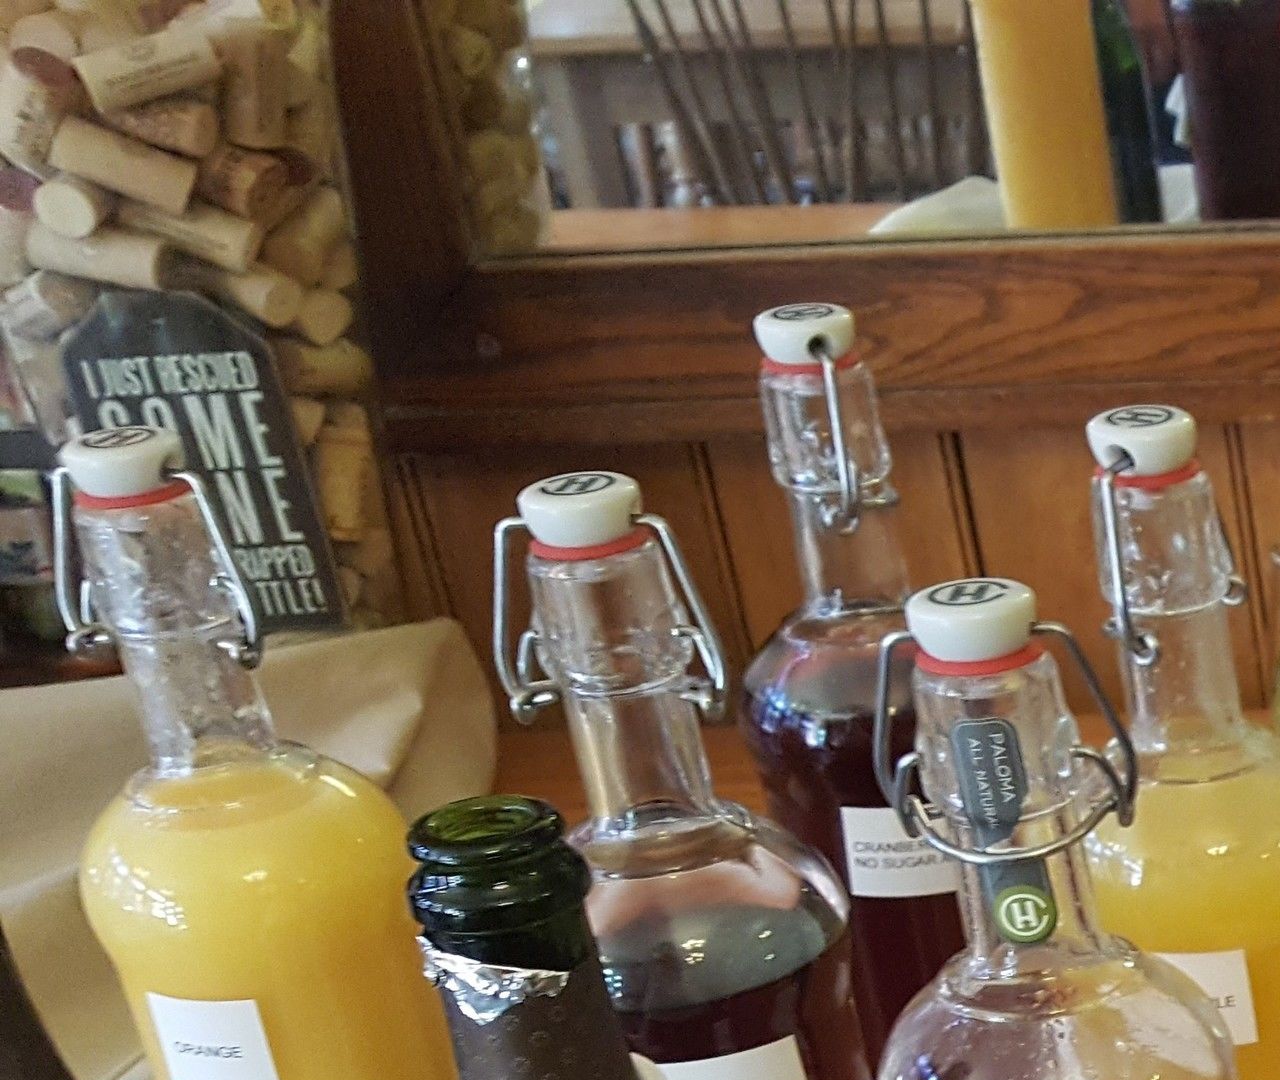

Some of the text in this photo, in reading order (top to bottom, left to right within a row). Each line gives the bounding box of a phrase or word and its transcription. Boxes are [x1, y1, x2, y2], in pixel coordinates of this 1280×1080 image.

[80, 351, 259, 399] I JUST RESCUED
[213, 467, 304, 545] NE
[230, 543, 317, 581] RAPPED
[254, 577, 329, 616] TTLE!
[967, 738, 1000, 829] ALL NATURAL
[988, 733, 1017, 803] PALOMA
[173, 1040, 244, 1060] ORANGE
